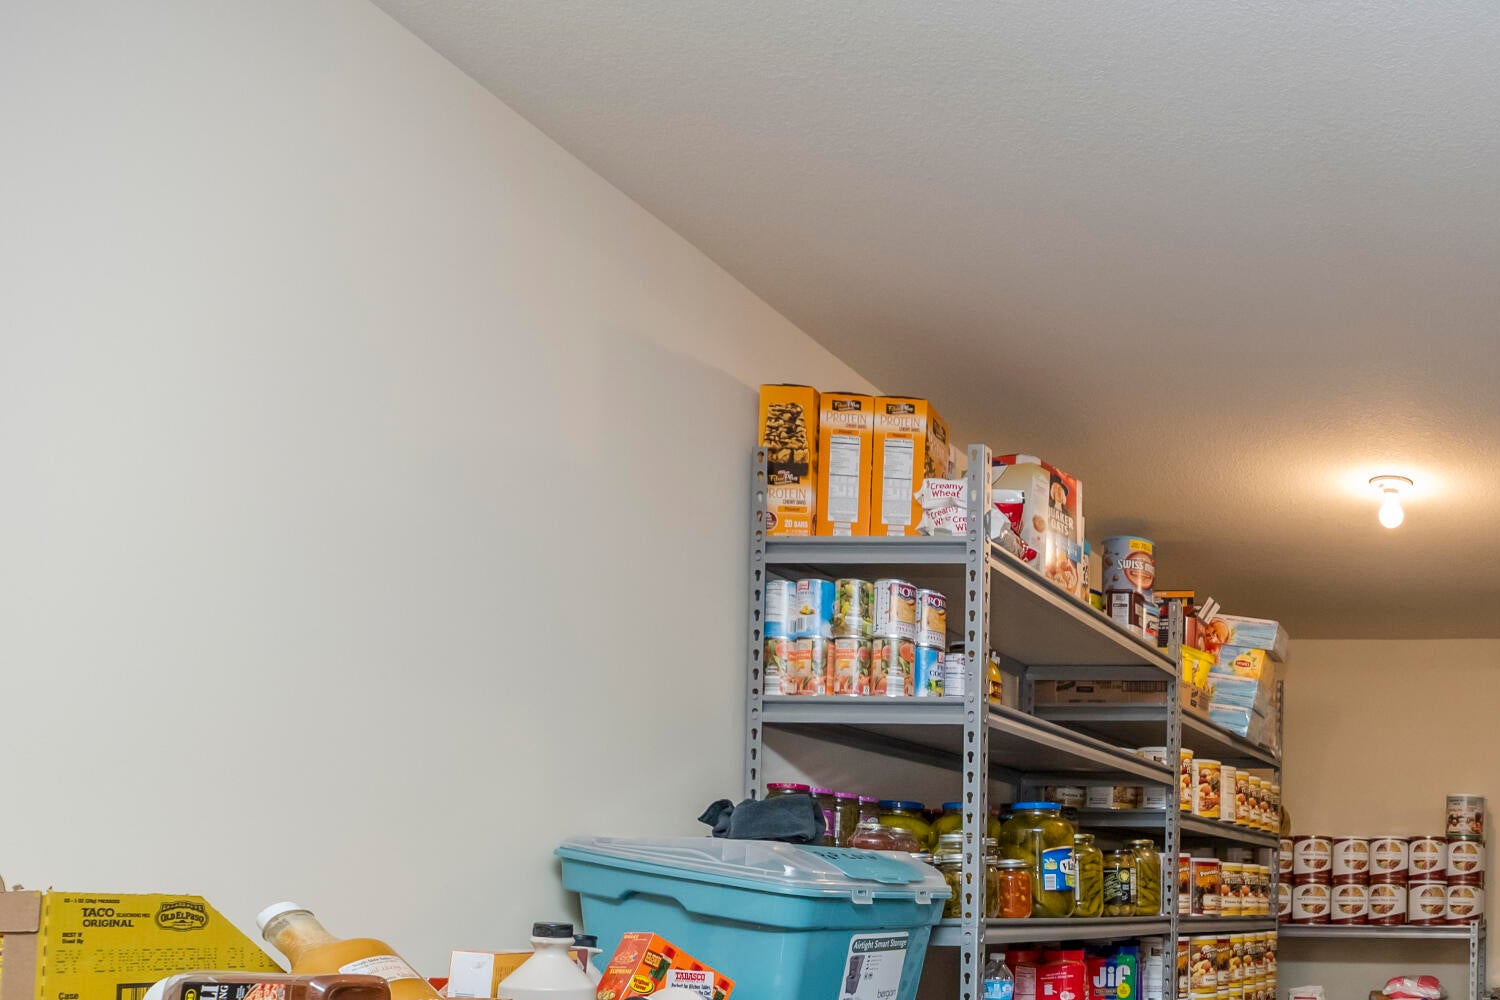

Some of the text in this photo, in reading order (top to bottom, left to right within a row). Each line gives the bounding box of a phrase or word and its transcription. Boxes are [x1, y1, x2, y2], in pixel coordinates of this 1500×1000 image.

[826, 413, 867, 424] PROTEIN
[880, 415, 920, 427] PROTEIN
[931, 483, 963, 491] Creamy
[766, 488, 806, 498] ROTEIN
[932, 490, 961, 498] Wheat
[1117, 559, 1144, 570] SWISS
[82, 907, 115, 918] TACO
[160, 913, 176, 923] OLD
[82, 919, 135, 928] ORIGINAL
[853, 940, 875, 951] Airtight
[874, 940, 890, 949] Smart
[675, 972, 706, 982] TABASCO
[1093, 965, 1131, 987] Jif
[58, 992, 79, 1000] Case
